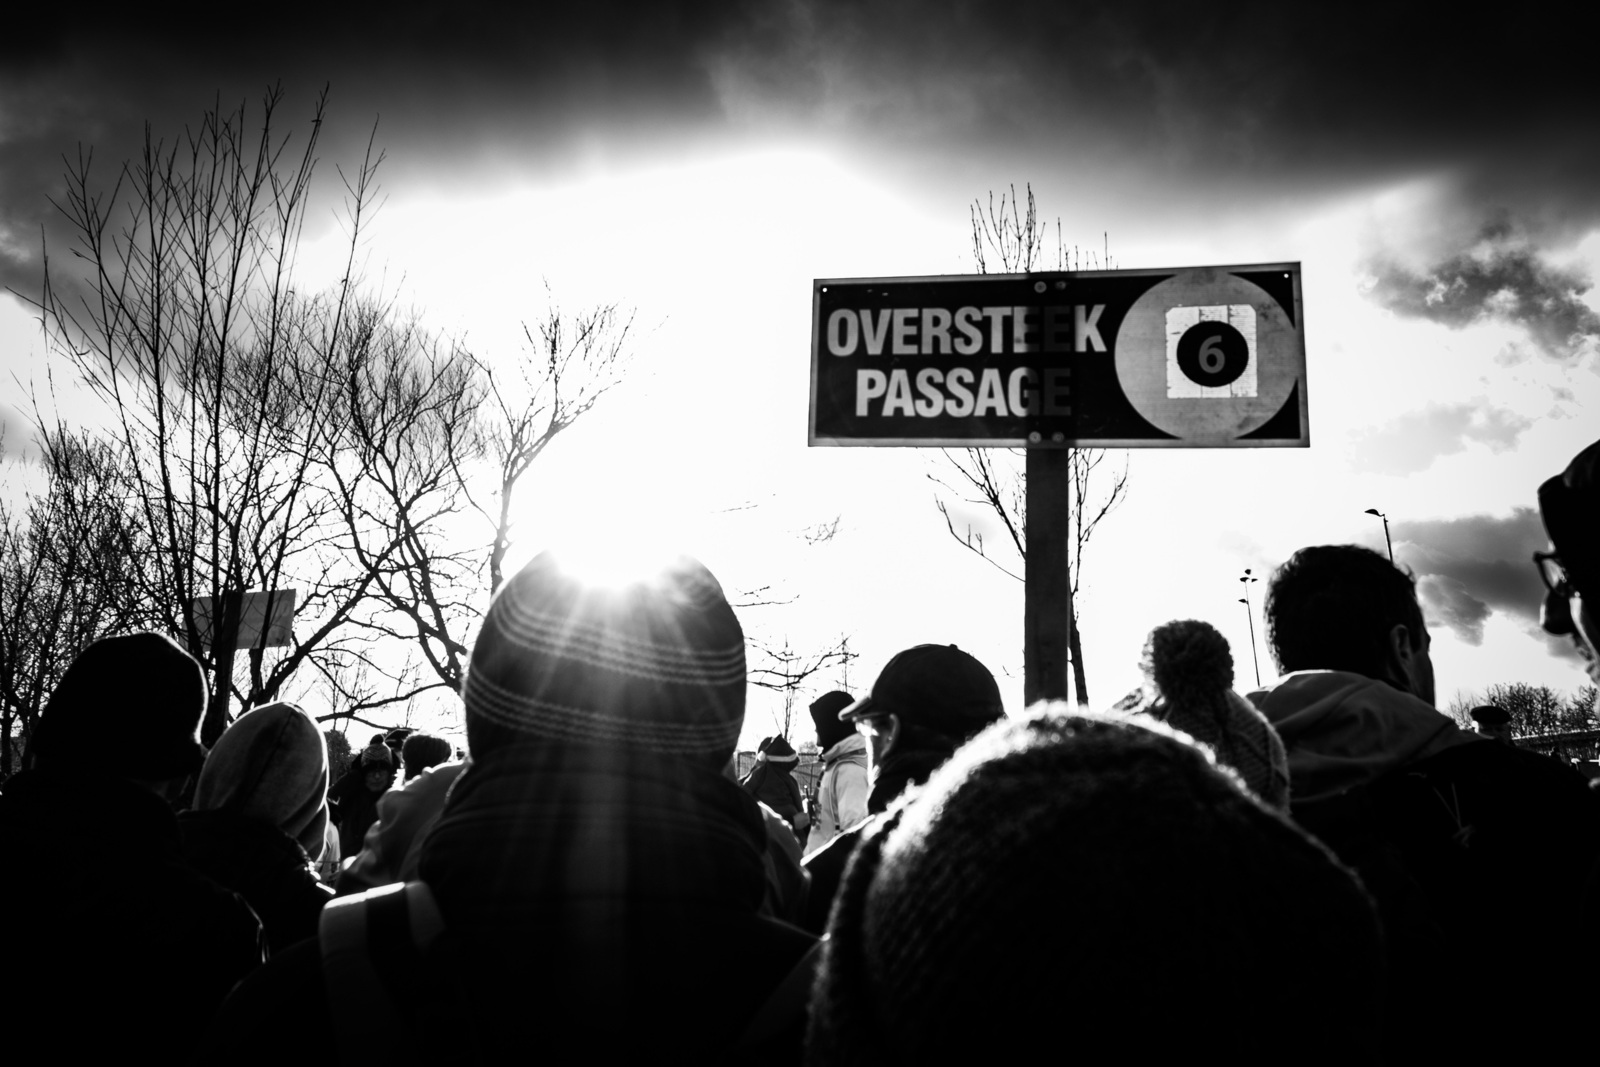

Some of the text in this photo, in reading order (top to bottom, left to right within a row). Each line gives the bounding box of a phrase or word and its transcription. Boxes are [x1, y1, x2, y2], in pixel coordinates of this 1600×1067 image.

[826, 304, 1107, 357] OVERSTEEK
[1199, 335, 1226, 374] 6
[855, 367, 1072, 418] PASSAGE
